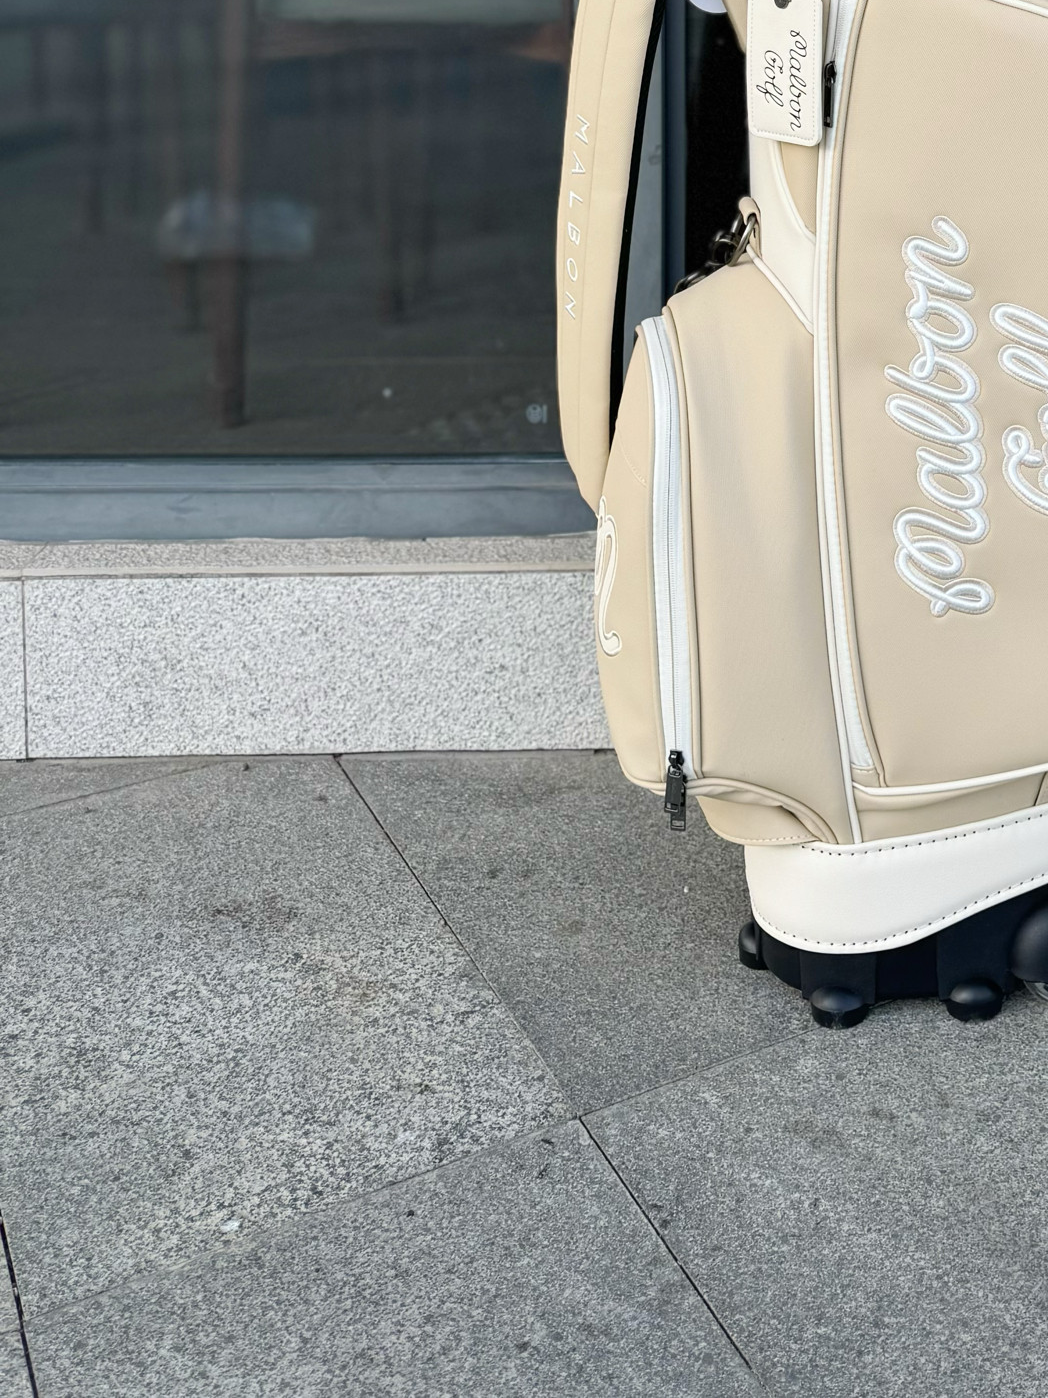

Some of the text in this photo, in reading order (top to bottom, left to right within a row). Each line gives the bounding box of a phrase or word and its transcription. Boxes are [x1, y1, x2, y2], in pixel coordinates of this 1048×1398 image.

[756, 50, 784, 107] Golf
[789, 30, 807, 131] Malbon
[565, 114, 590, 319] MALBON
[884, 216, 995, 617] Malbon
